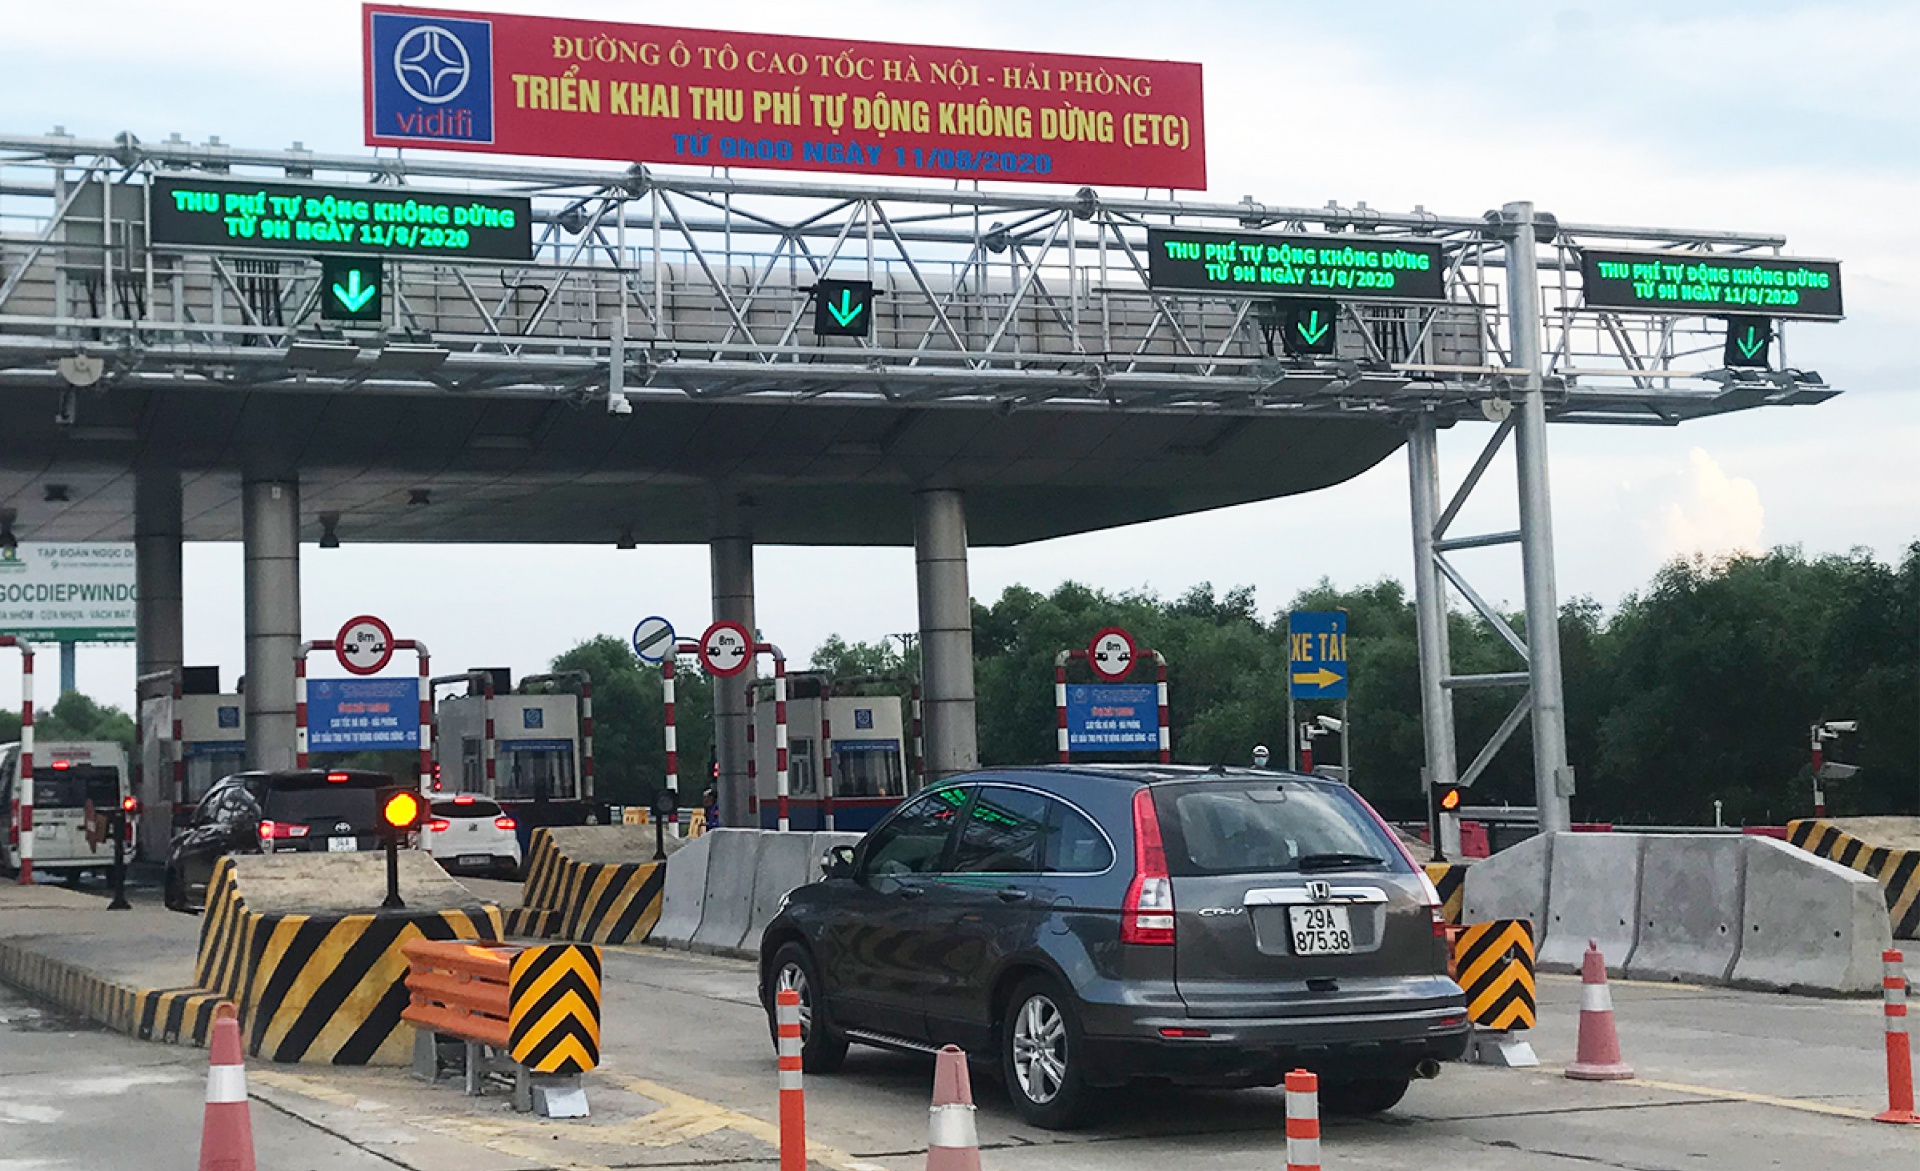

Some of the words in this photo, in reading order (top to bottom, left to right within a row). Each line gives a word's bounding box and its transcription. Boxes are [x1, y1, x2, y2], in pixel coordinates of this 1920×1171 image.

[552, 33, 661, 66] ĐƯỜNG
[668, 40, 691, 68] Ô
[698, 43, 738, 71] TÔ
[746, 51, 808, 76] CAO
[815, 48, 875, 81] TỐC
[882, 55, 921, 84] HÀ
[929, 59, 980, 91] NỘI
[1003, 62, 1051, 91] HẢI
[1059, 67, 1152, 97] PHÒNG
[512, 65, 600, 113] TRIỂN
[610, 82, 680, 119] KHAI
[689, 87, 743, 121] THU
[753, 86, 801, 125] PHÍ
[810, 93, 848, 136] TỰ
[853, 92, 930, 138] ĐỘNG
[939, 97, 1032, 139] KHÔNG
[1041, 101, 1113, 143] DỪNG
[1123, 113, 1190, 150] (ETC)
[396, 108, 474, 138] vidifi
[671, 129, 713, 156] TỪ
[719, 137, 794, 161] 9h00
[803, 140, 882, 166] NGÀY
[893, 146, 1053, 174] 11/08/2020
[171, 190, 220, 212] THU
[225, 190, 267, 216] PHÍ
[268, 195, 302, 220] TỰ
[304, 195, 369, 221] ĐỘNG
[373, 199, 450, 225] KHÔNG
[453, 203, 515, 229] DỪNG
[223, 214, 258, 238] TỪ
[260, 219, 291, 241] 9H
[295, 219, 355, 243] NGÀY
[359, 223, 470, 249] 11/8/2020
[1164, 241, 1200, 260] THU
[1204, 240, 1237, 262] PHÍ
[1238, 244, 1264, 266] TỰ
[1266, 243, 1317, 266] ĐỘNG
[1319, 246, 1379, 267] KHÔNG
[1381, 249, 1430, 270] DỪNG
[1204, 261, 1230, 281] TỪ
[1233, 265, 1256, 283] 9H
[1260, 263, 1306, 284] NGÀY
[1309, 268, 1395, 289] 11/8/2020
[1597, 262, 1630, 278] THU
[1633, 260, 1661, 281] PHÍ
[1662, 263, 1685, 284] TỰ
[1686, 263, 1730, 284] ĐỘNG
[1731, 265, 1784, 286] KHÔNG
[1786, 267, 1829, 289] DỪNG
[1633, 280, 1656, 299] TỪ
[1657, 284, 1678, 300] 9H
[1681, 282, 1722, 302] NGÀY
[1723, 286, 1799, 305] 11/8/2020
[718, 635, 736, 646] 8m
[1290, 633, 1313, 662] XE
[1318, 621, 1347, 662] TẢI
[1304, 908, 1336, 930] 29A
[1295, 930, 1350, 953] 875.38
